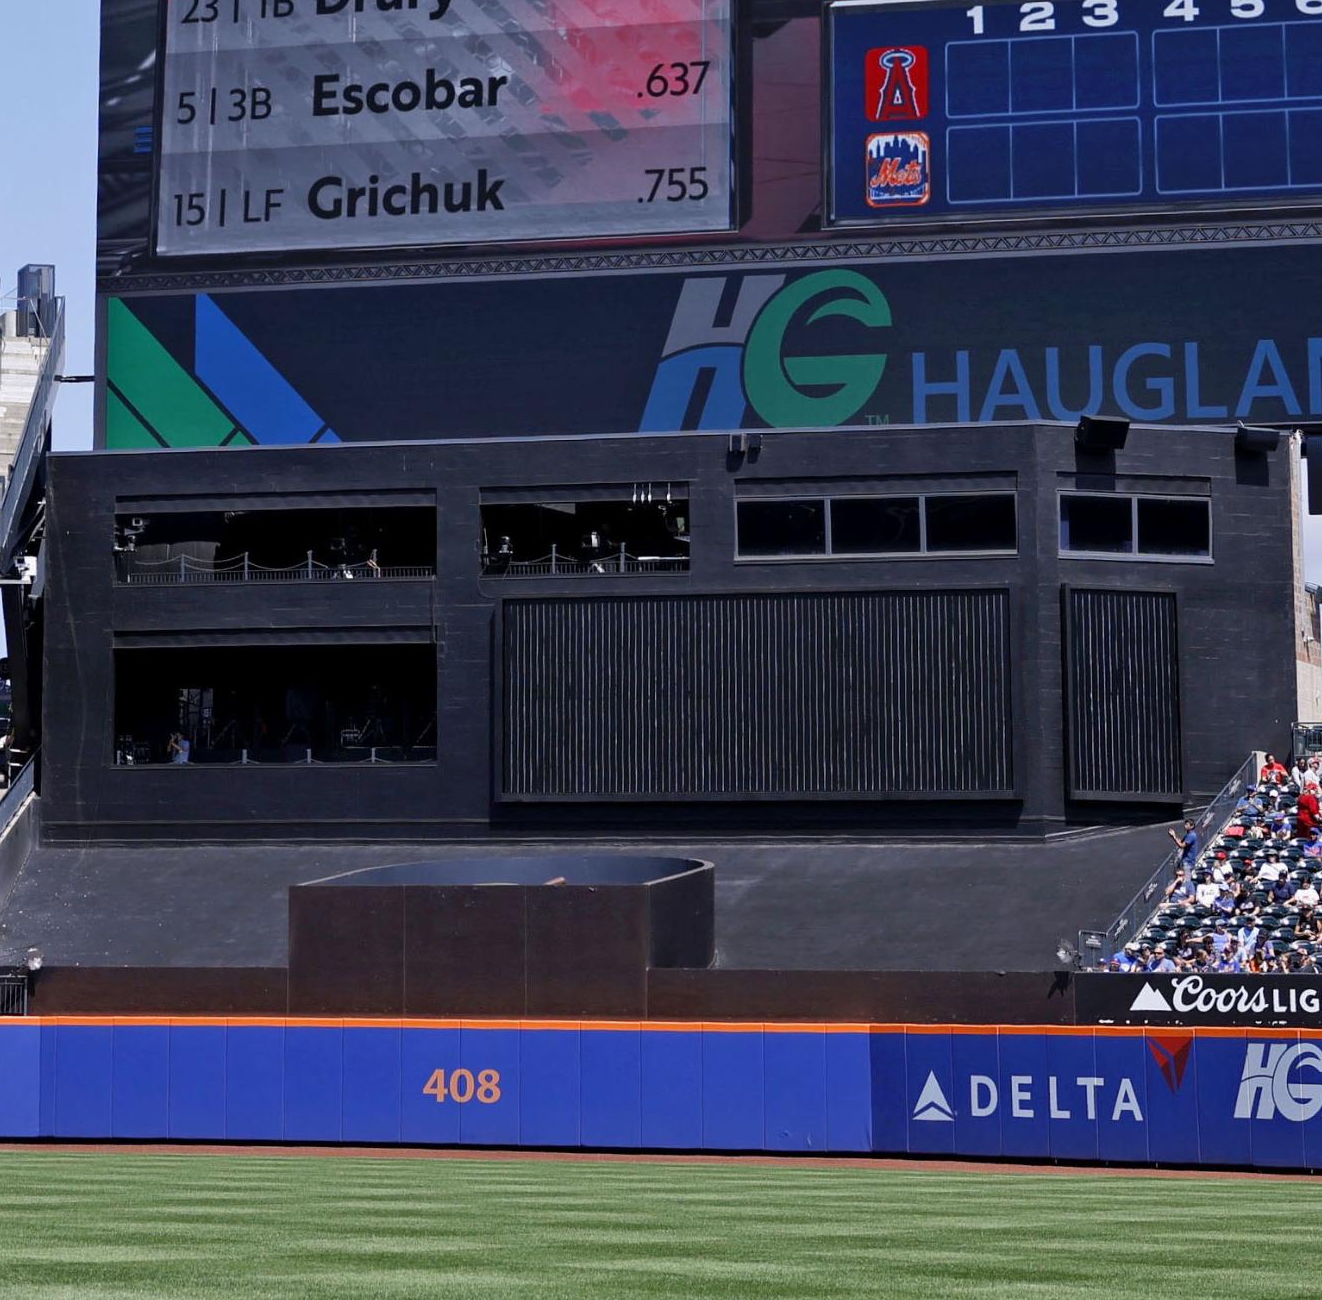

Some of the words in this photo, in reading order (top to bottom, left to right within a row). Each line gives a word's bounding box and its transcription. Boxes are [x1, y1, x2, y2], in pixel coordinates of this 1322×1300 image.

[967, 6, 985, 34] 1
[1019, 2, 1057, 32] 2
[177, 91, 197, 125] 5
[228, 87, 273, 123] 3B
[311, 68, 508, 117] Escobar
[636, 61, 711, 99] .637
[174, 191, 206, 227] 15
[242, 188, 284, 224] LF
[307, 169, 506, 220] Grichuk
[636, 167, 709, 204] .755
[1172, 976, 1269, 1015] Coors
[423, 1068, 501, 1104] 408
[970, 1074, 1144, 1123] DELTA
